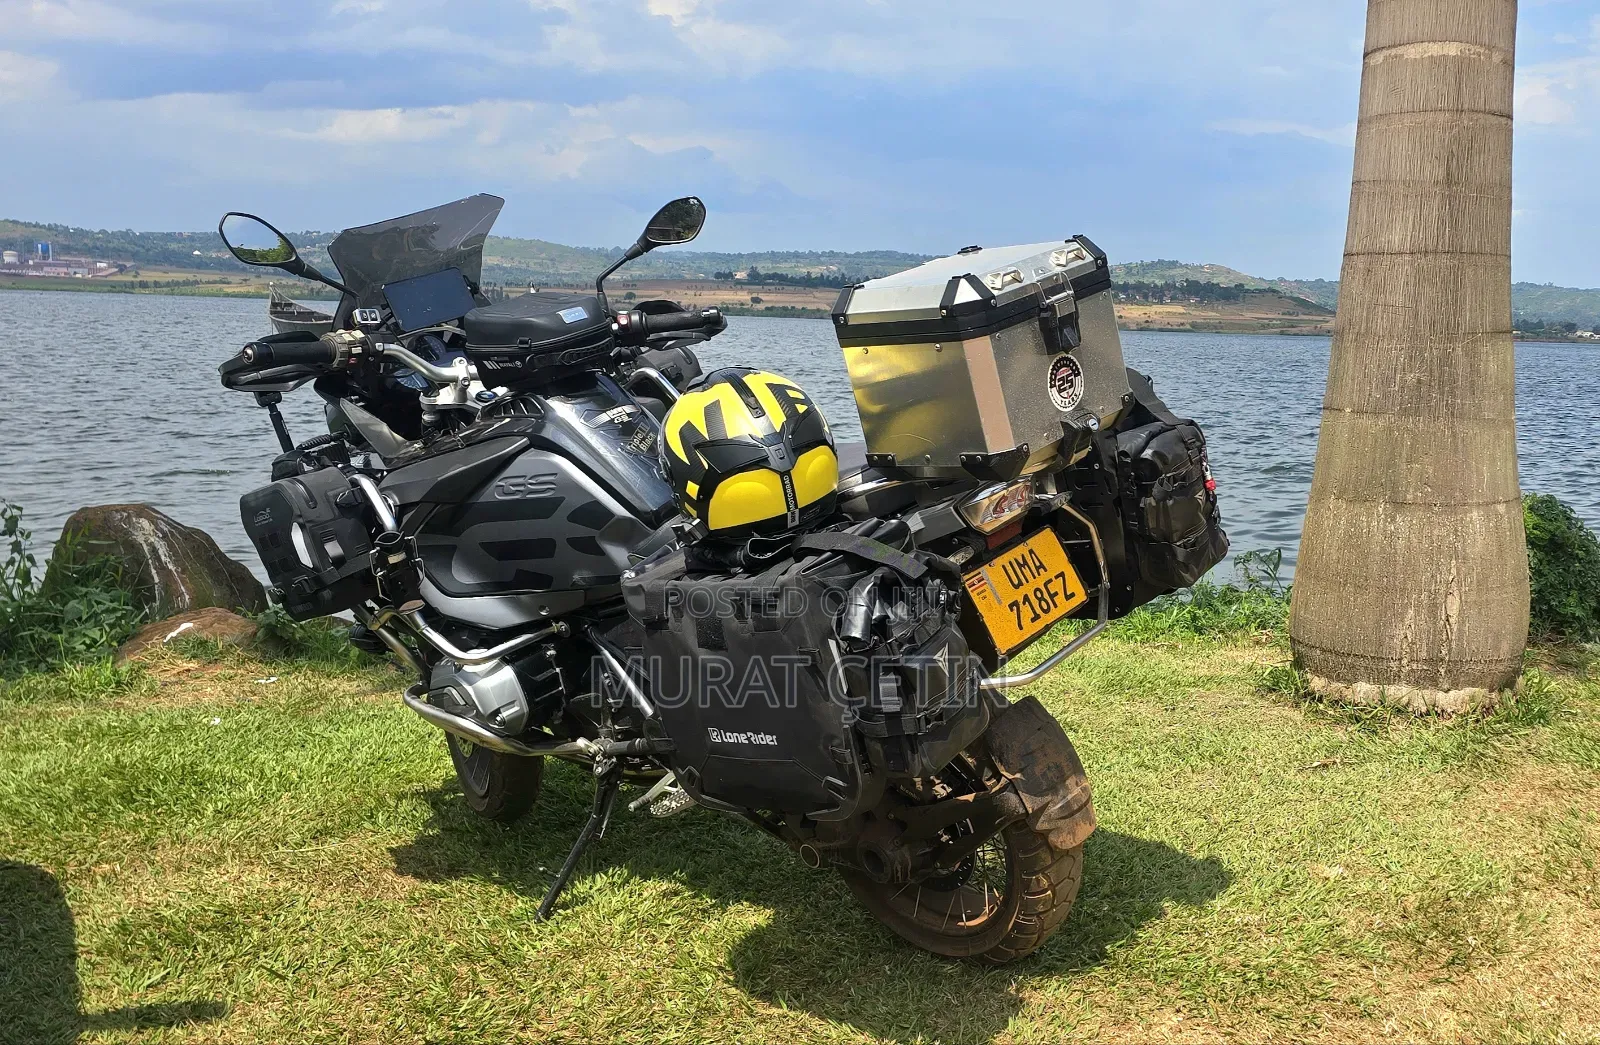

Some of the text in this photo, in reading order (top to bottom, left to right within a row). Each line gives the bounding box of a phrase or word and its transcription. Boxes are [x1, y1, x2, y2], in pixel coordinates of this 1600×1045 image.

[639, 432, 656, 452] Black
[494, 472, 558, 500] GS
[1001, 548, 1048, 590] UMA
[1007, 570, 1076, 631] 718FZ
